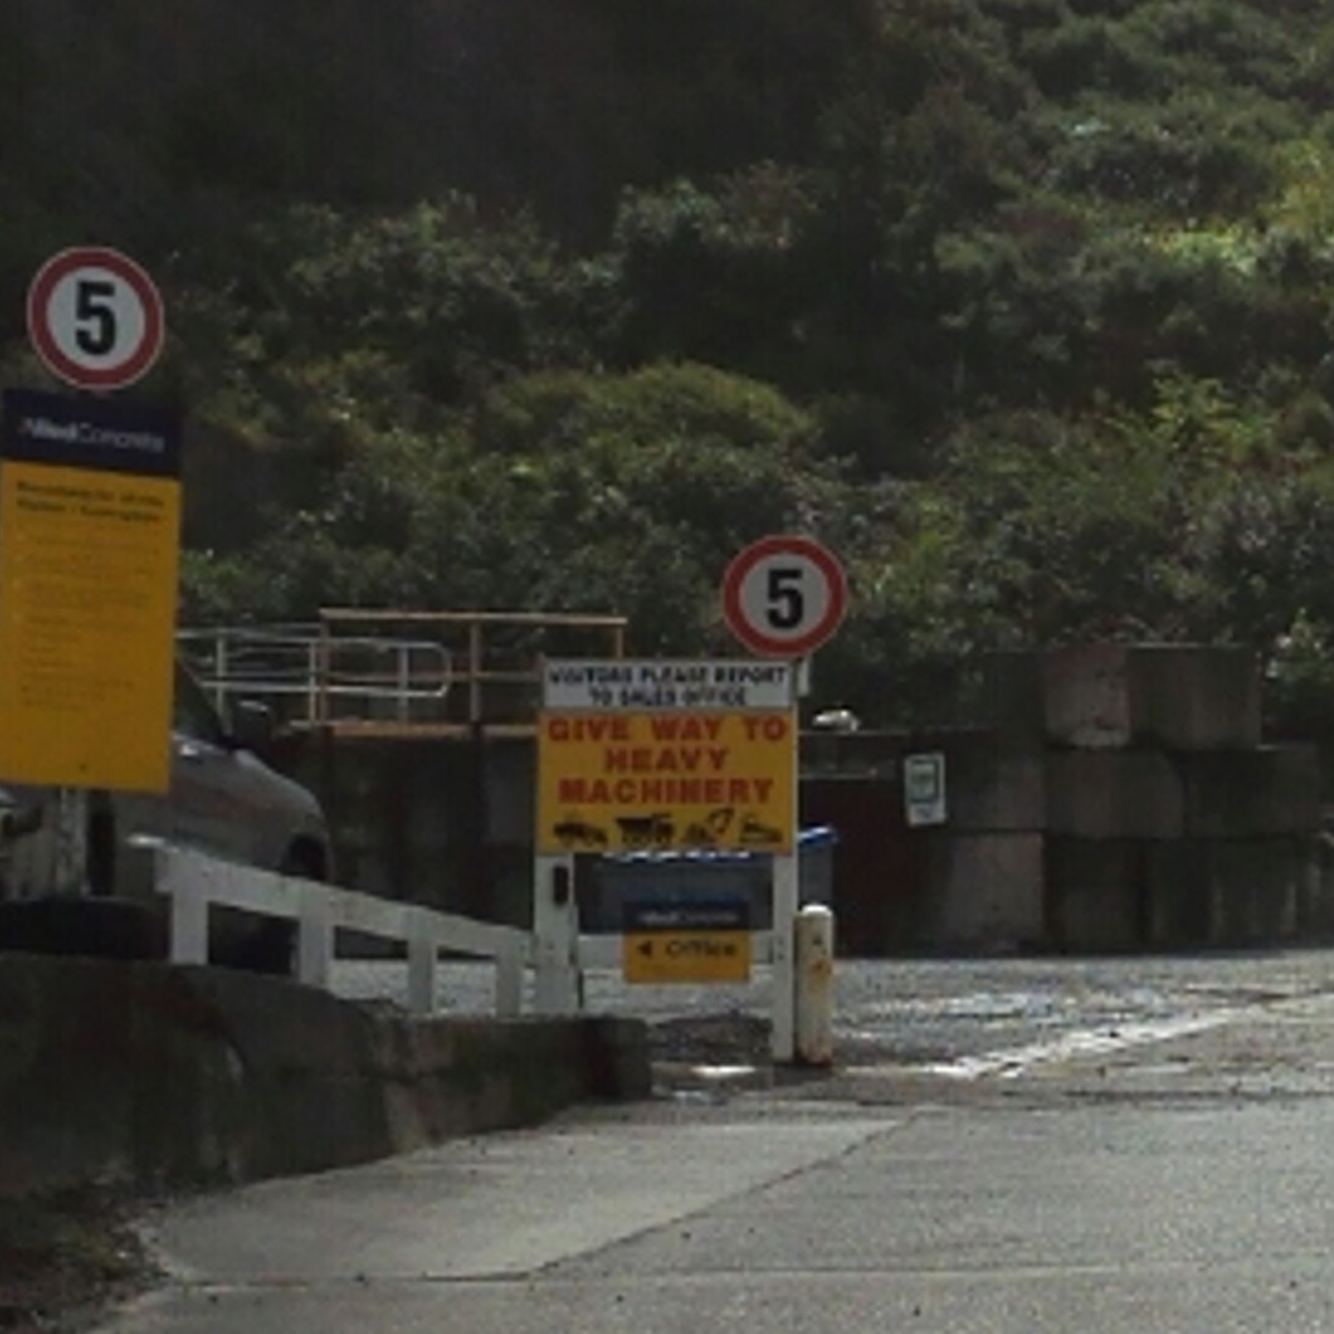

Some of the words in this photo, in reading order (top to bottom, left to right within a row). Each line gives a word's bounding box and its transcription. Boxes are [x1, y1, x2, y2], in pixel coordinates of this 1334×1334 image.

[74, 280, 117, 357] 5
[765, 568, 805, 630] 5
[640, 666, 708, 684] PLEASE
[714, 666, 786, 684] REPORT
[548, 717, 631, 741] GIVE
[651, 716, 723, 740] WAY
[742, 716, 788, 740] TO
[604, 747, 729, 772] HEAVY
[558, 778, 774, 804] MACHINERY
